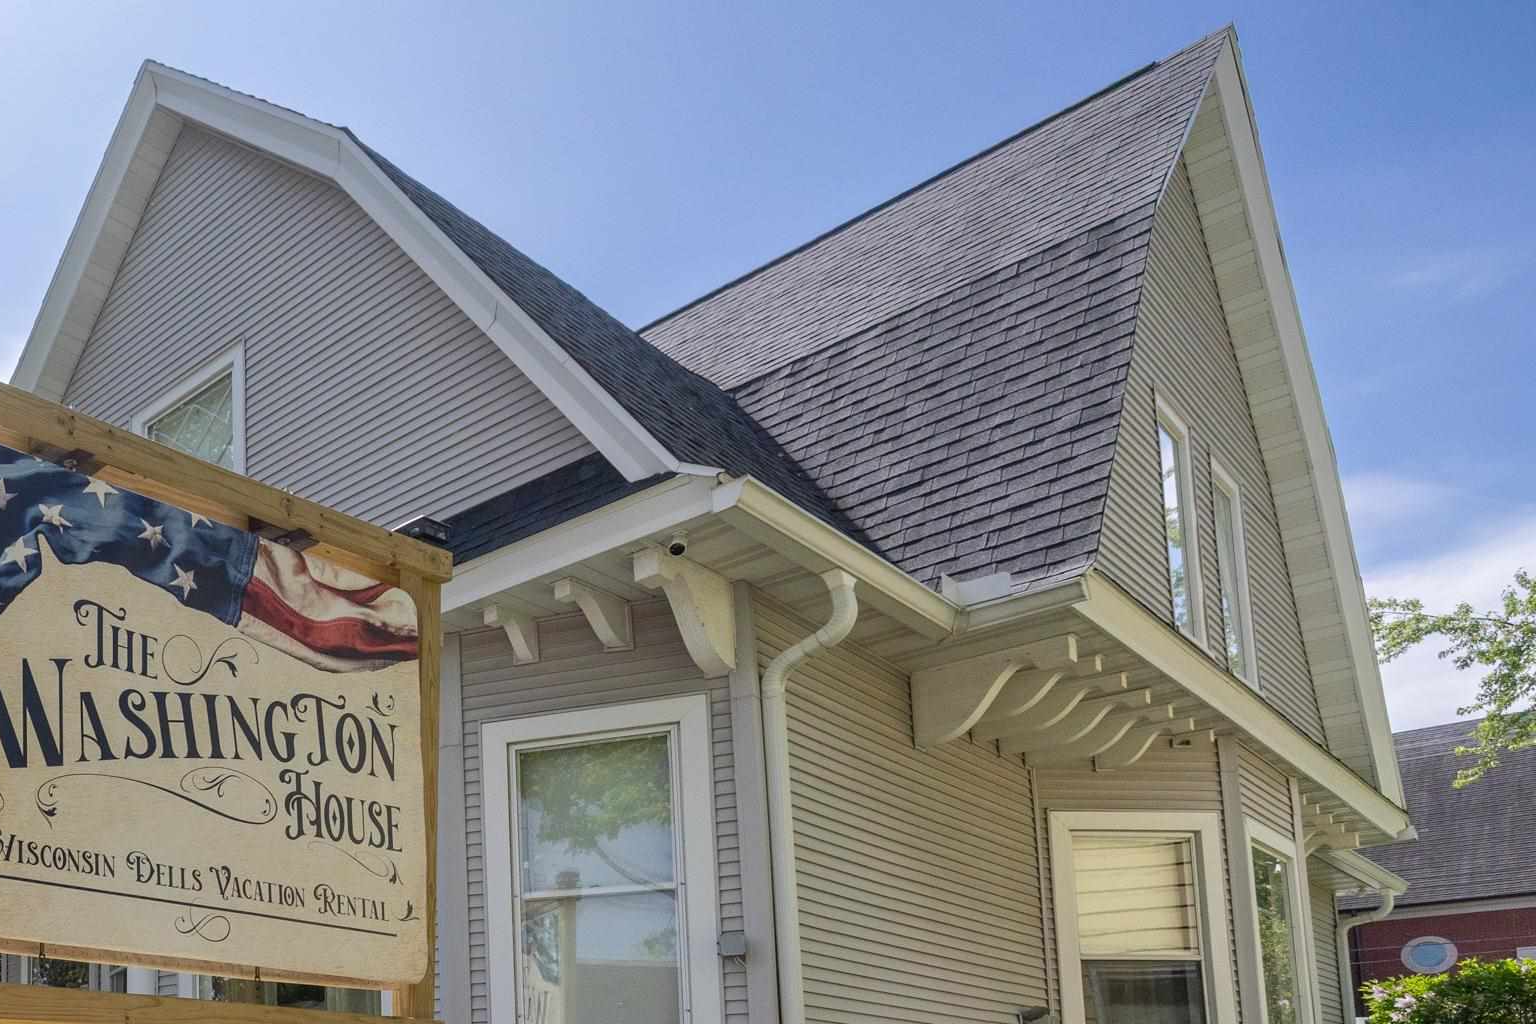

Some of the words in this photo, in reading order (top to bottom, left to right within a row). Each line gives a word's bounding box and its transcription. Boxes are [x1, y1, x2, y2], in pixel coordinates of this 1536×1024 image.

[73, 599, 159, 681] THE
[278, 768, 403, 853] HOUSE
[125, 849, 203, 892] DELLS
[208, 864, 305, 909] VACATION
[313, 882, 391, 922] RENTAL
